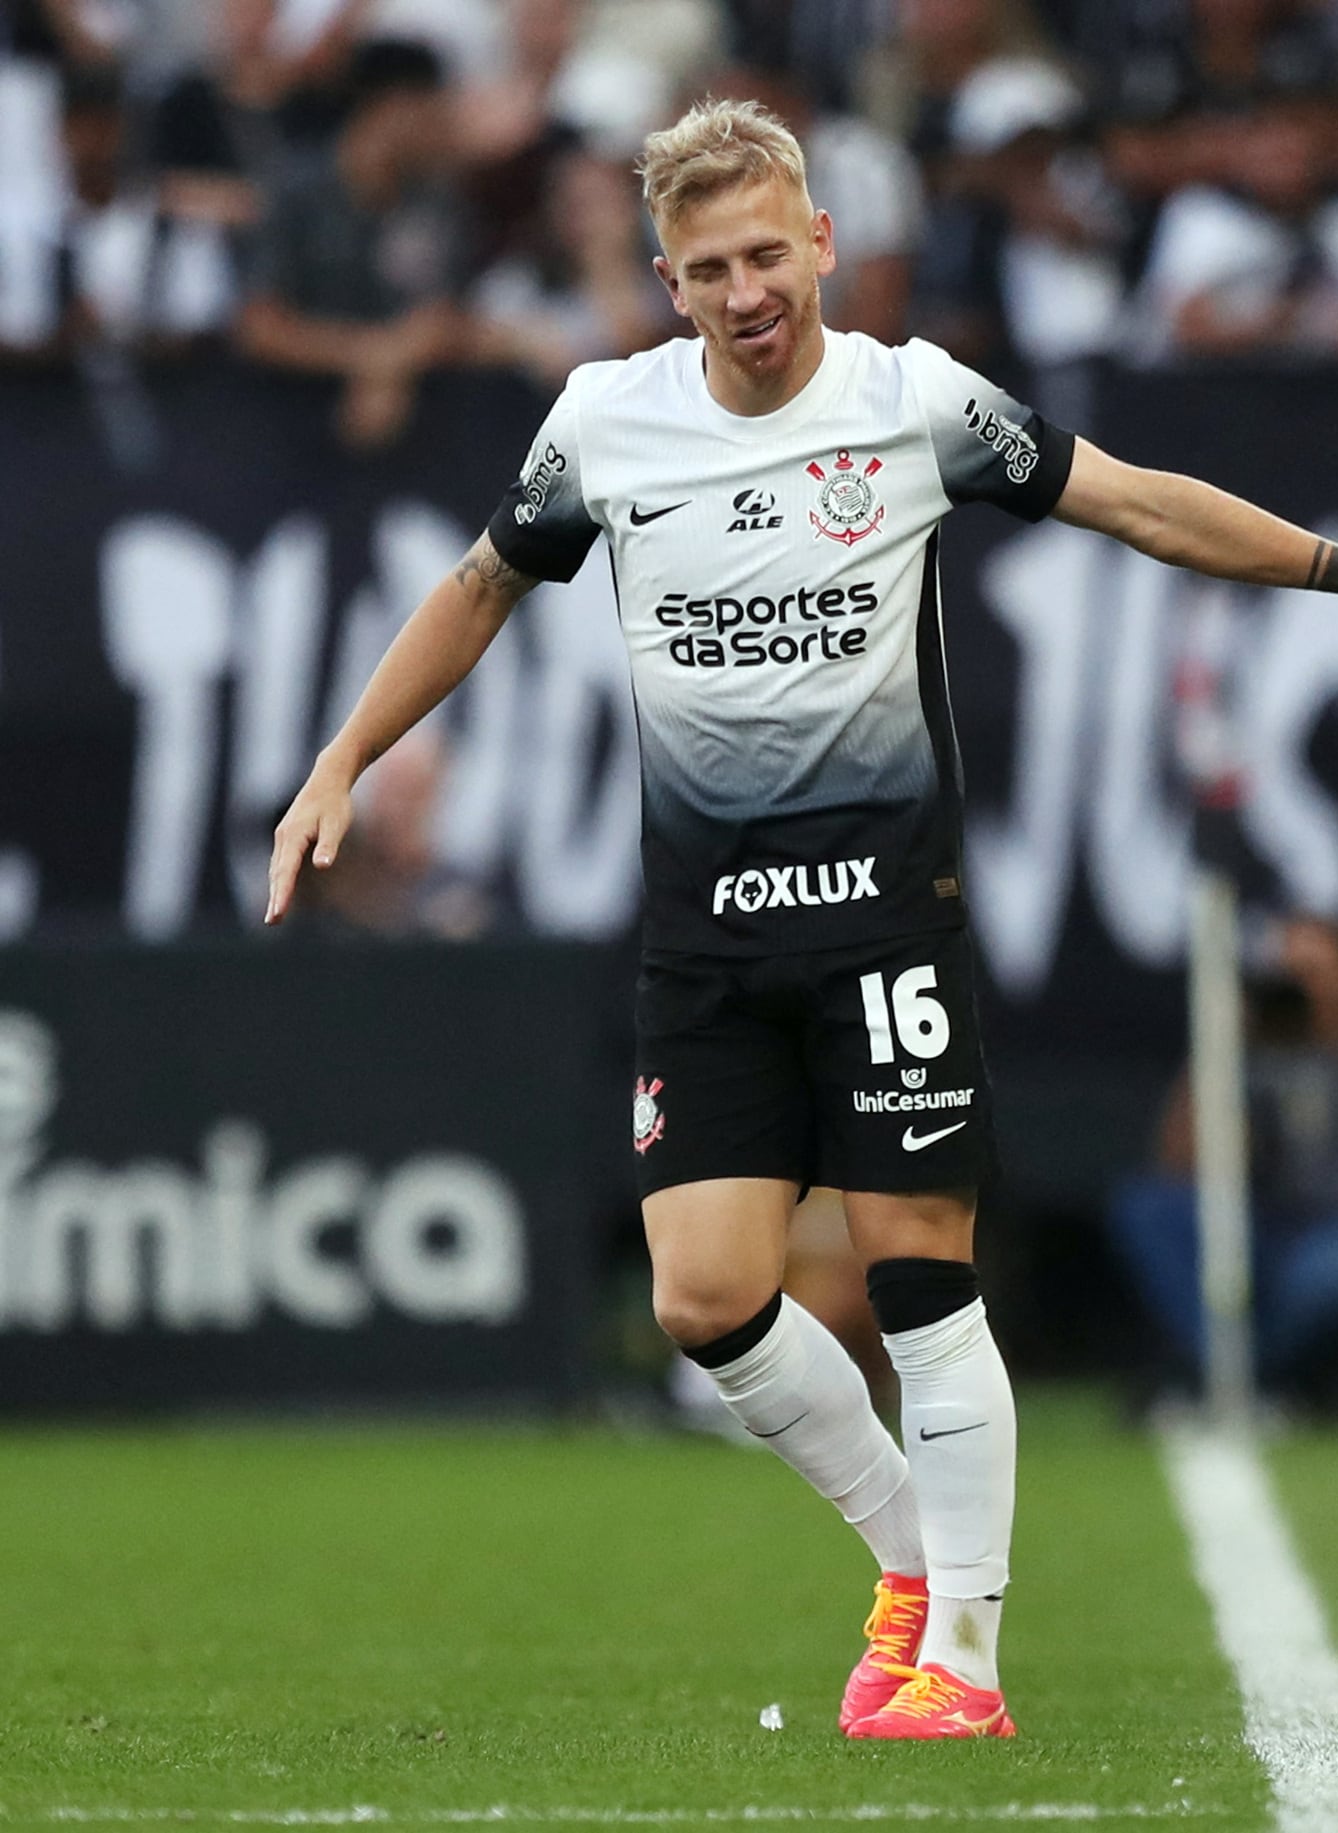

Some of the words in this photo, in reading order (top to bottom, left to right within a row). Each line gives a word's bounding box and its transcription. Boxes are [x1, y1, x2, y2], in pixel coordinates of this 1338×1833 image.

[725, 516, 784, 533] ALE
[655, 581, 878, 635] Esportes
[713, 856, 880, 915] FOXLUX
[859, 964, 950, 1064] 16
[853, 1088, 974, 1113] UniCesumar
